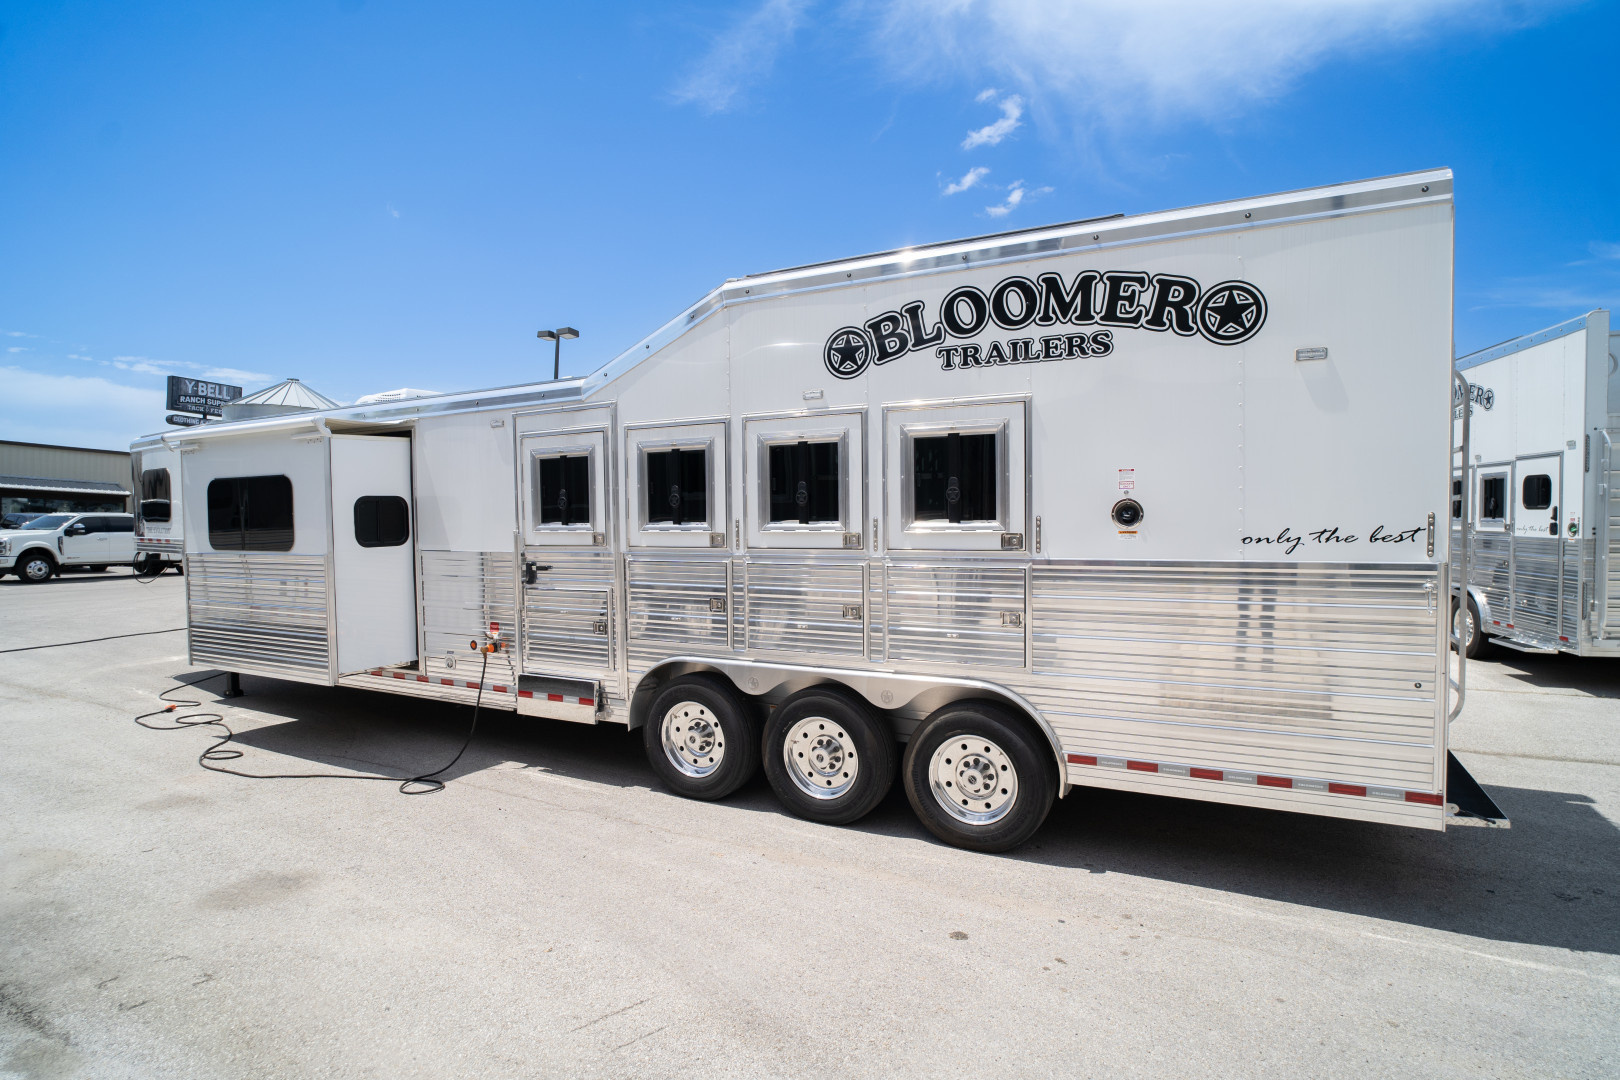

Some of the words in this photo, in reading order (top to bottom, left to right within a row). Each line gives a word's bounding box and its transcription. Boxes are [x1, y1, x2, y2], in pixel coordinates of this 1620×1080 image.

[865, 269, 1201, 365] BLOOMER
[936, 330, 1114, 371] TRAILERS
[180, 395, 206, 404] RANCH
[185, 379, 230, 400] Y-BELL
[188, 404, 204, 412] TACK
[1241, 527, 1304, 555] only
[1309, 526, 1359, 544] the
[1369, 525, 1427, 543] best
